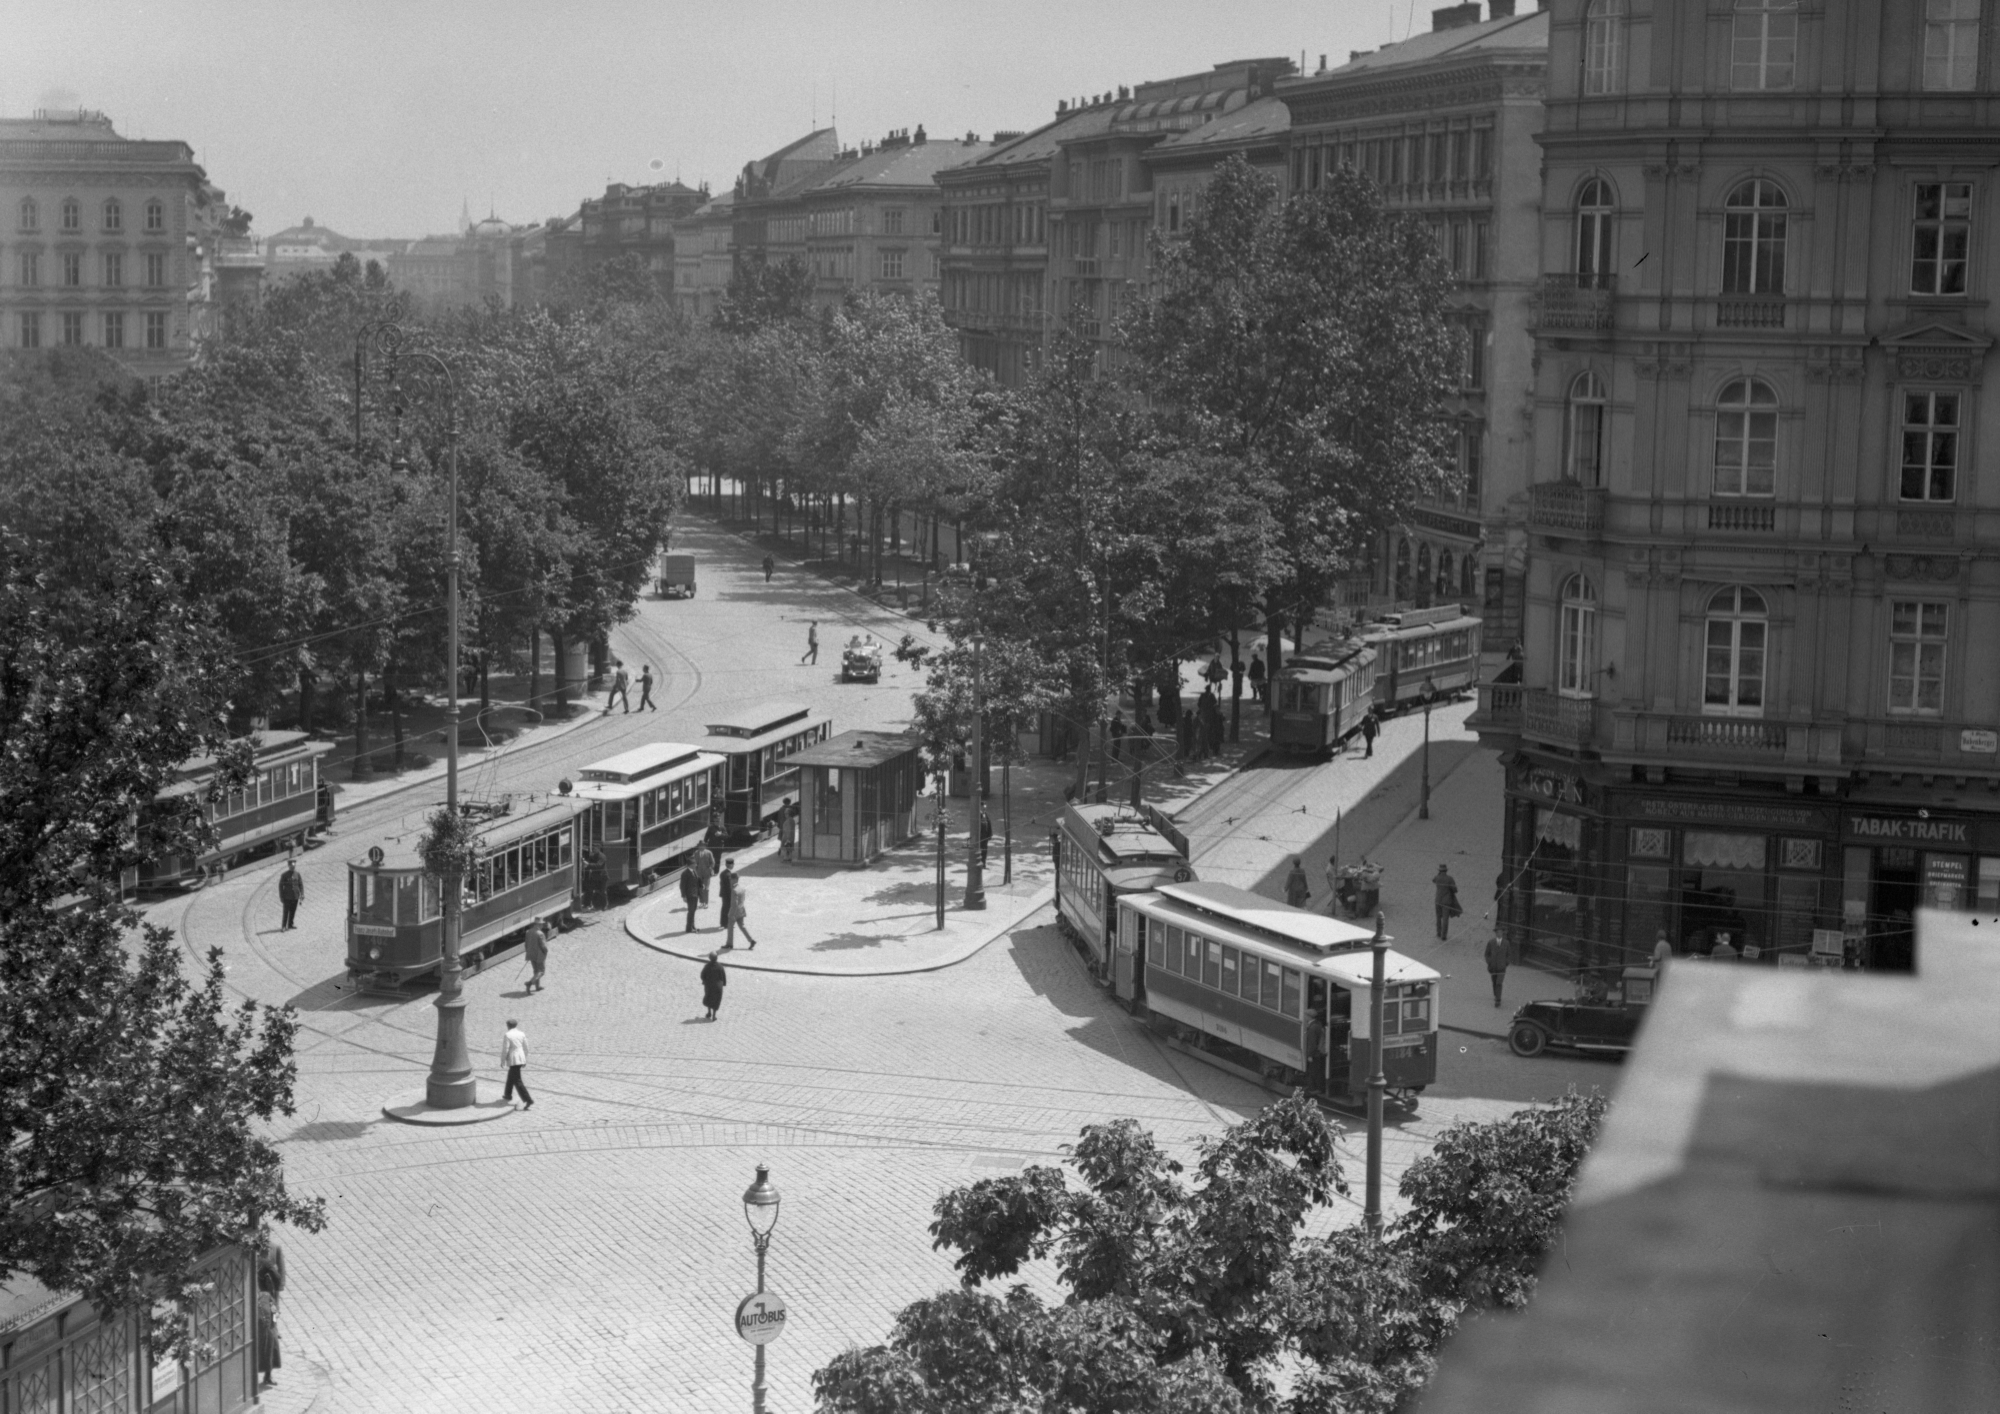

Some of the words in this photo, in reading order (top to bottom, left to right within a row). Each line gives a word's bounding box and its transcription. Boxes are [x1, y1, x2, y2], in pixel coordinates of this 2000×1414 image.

[1530, 775, 1582, 803] KOHN
[1795, 809, 1812, 817] VON
[1851, 817, 1966, 841] TABAK-TRAFIK
[373, 847, 380, 861] D
[1932, 861, 1963, 870] STEMPEL
[1177, 871, 1188, 882] 57
[1927, 871, 1965, 880] BRIEFMARKEN
[741, 1310, 785, 1327] AUTOBUS
